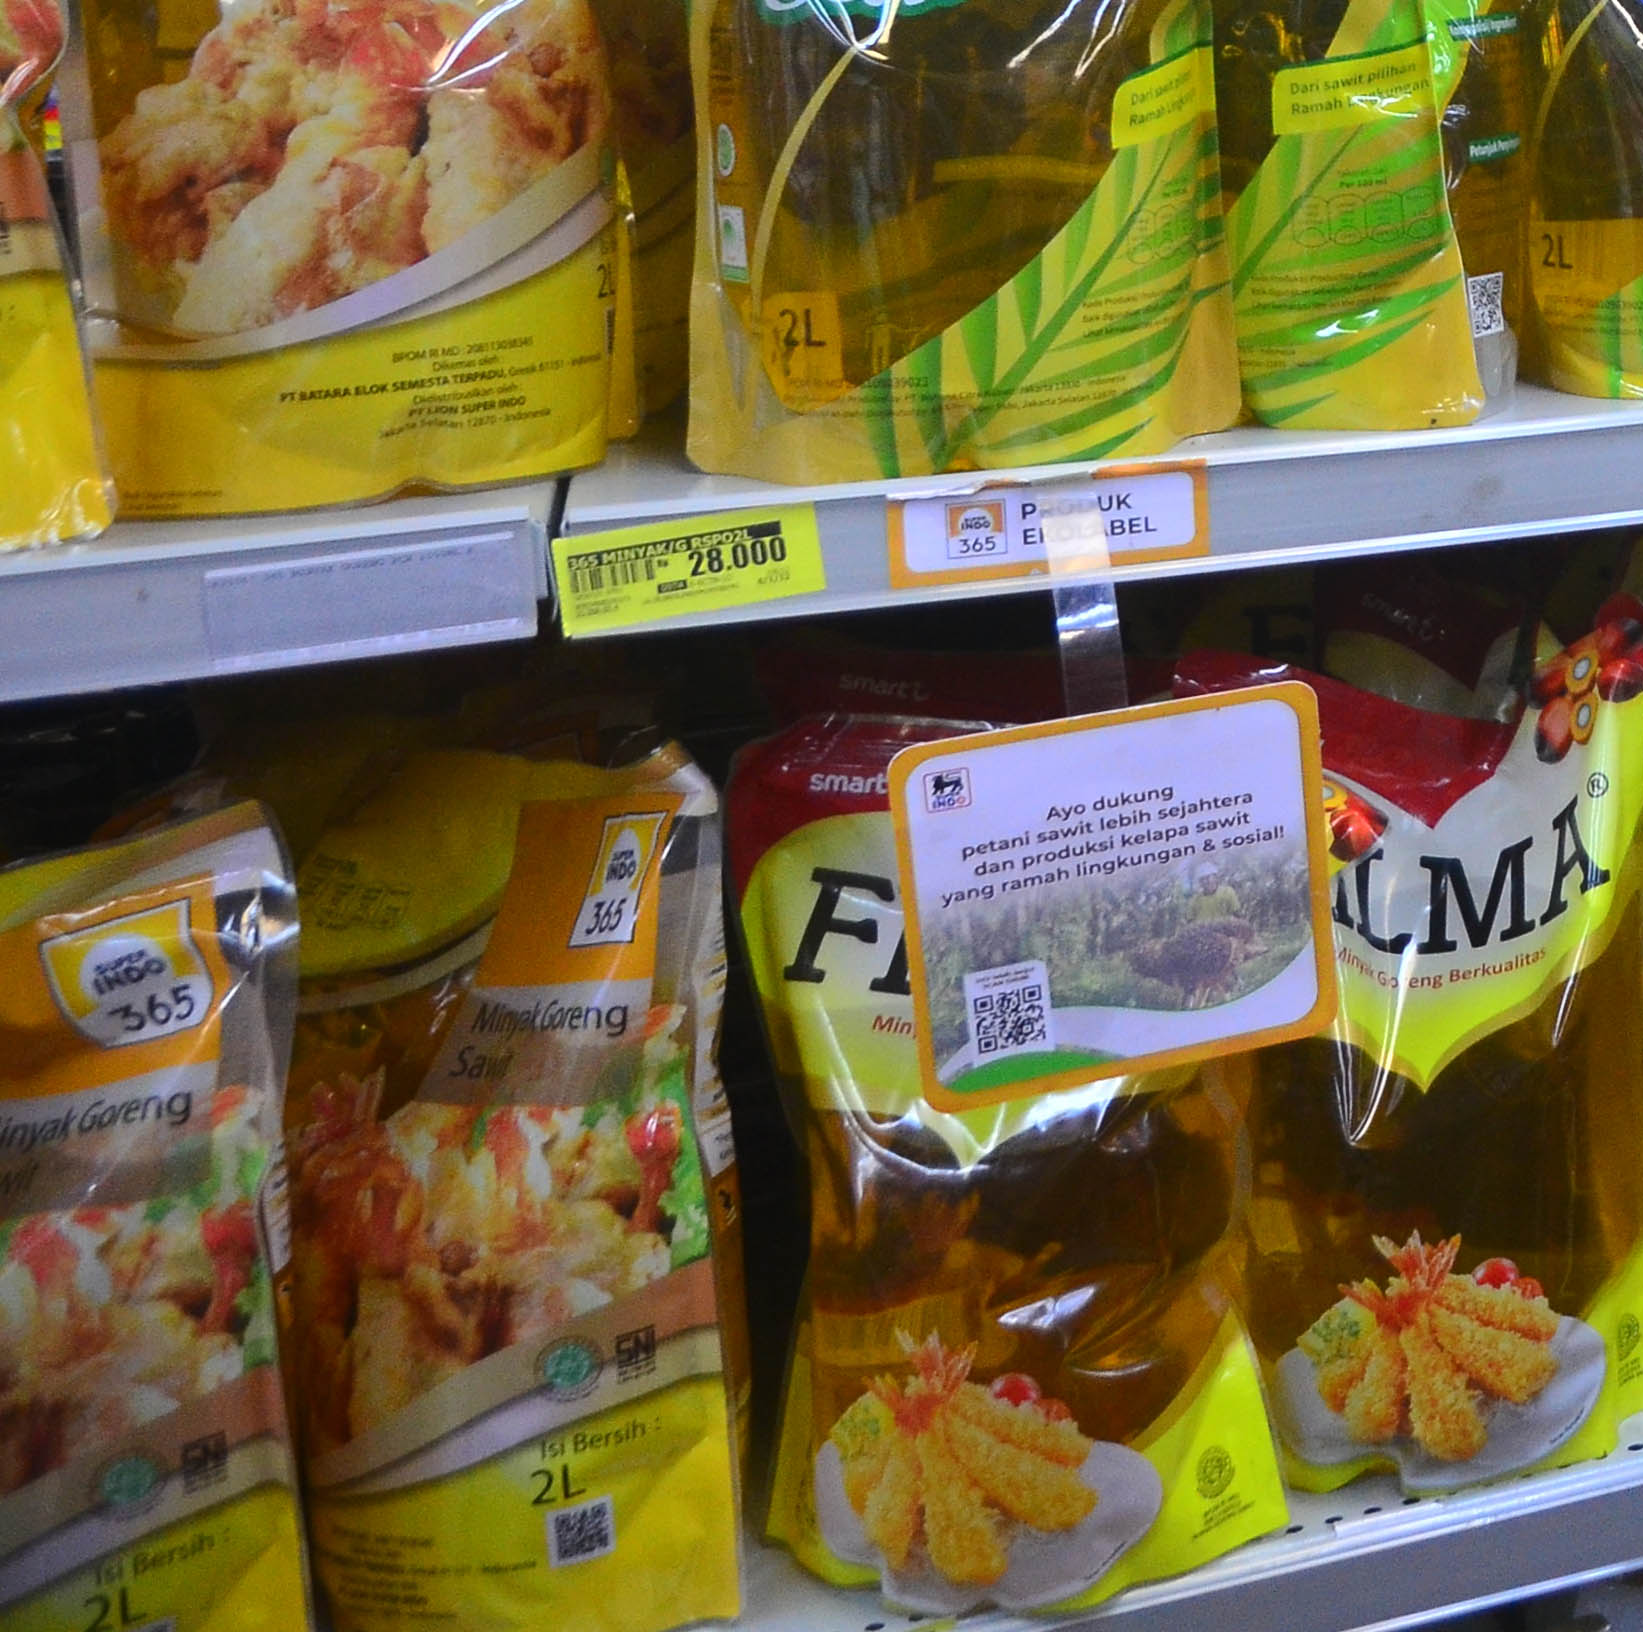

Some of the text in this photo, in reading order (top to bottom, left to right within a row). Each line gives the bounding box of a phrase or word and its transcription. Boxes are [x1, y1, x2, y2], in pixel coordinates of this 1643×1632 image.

[1290, 60, 1417, 96] Dari sawit pilihan
[1290, 97, 1343, 116] Ramah
[1540, 234, 1572, 270] 2L
[779, 309, 827, 349] 2L
[280, 391, 298, 403] PT
[300, 387, 352, 402] BATARA
[354, 382, 389, 397] ELOK
[391, 376, 450, 394] SEMESTA
[568, 540, 688, 570] 365 MINYAK/G
[688, 536, 787, 578] 28.000
[958, 536, 997, 555] 365
[1046, 783, 1175, 822] Ayo dukung
[961, 790, 1254, 863] petani sawit lebih sejahtera
[973, 811, 1252, 878] dan produksi kelapa sawit
[606, 860, 637, 883] INDO
[940, 825, 1286, 908] yang ramah lingkungan & sosial!
[1330, 795, 1610, 955] ILMA
[584, 897, 628, 936] 365
[1448, 945, 1547, 985] Berkualitas
[108, 983, 196, 1032] 365
[471, 999, 629, 1042] Minyak Goreng
[78, 1090, 193, 1136] Goreng
[540, 1423, 647, 1461] Isi Bersih
[530, 1464, 586, 1507] 2L
